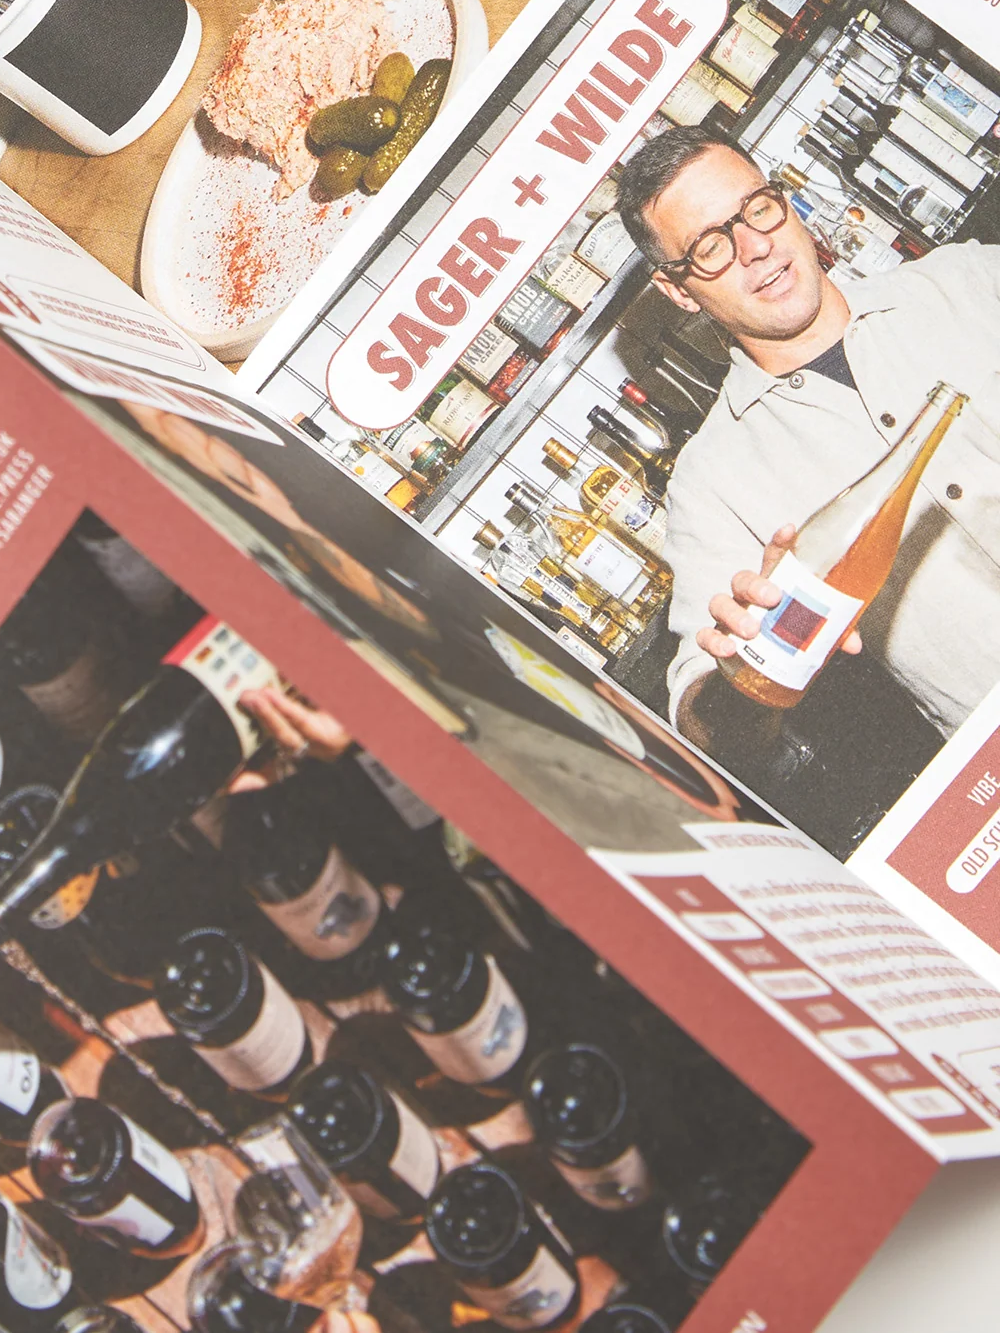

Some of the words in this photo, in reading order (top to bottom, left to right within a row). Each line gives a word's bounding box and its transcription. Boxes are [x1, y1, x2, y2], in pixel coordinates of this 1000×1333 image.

[366, 217, 525, 391] SAGER
[511, 173, 549, 208] +
[500, 284, 538, 324] KNOB
[464, 327, 497, 366] KNOB
[966, 771, 1000, 806] VIBE
[961, 847, 989, 876] OLD
